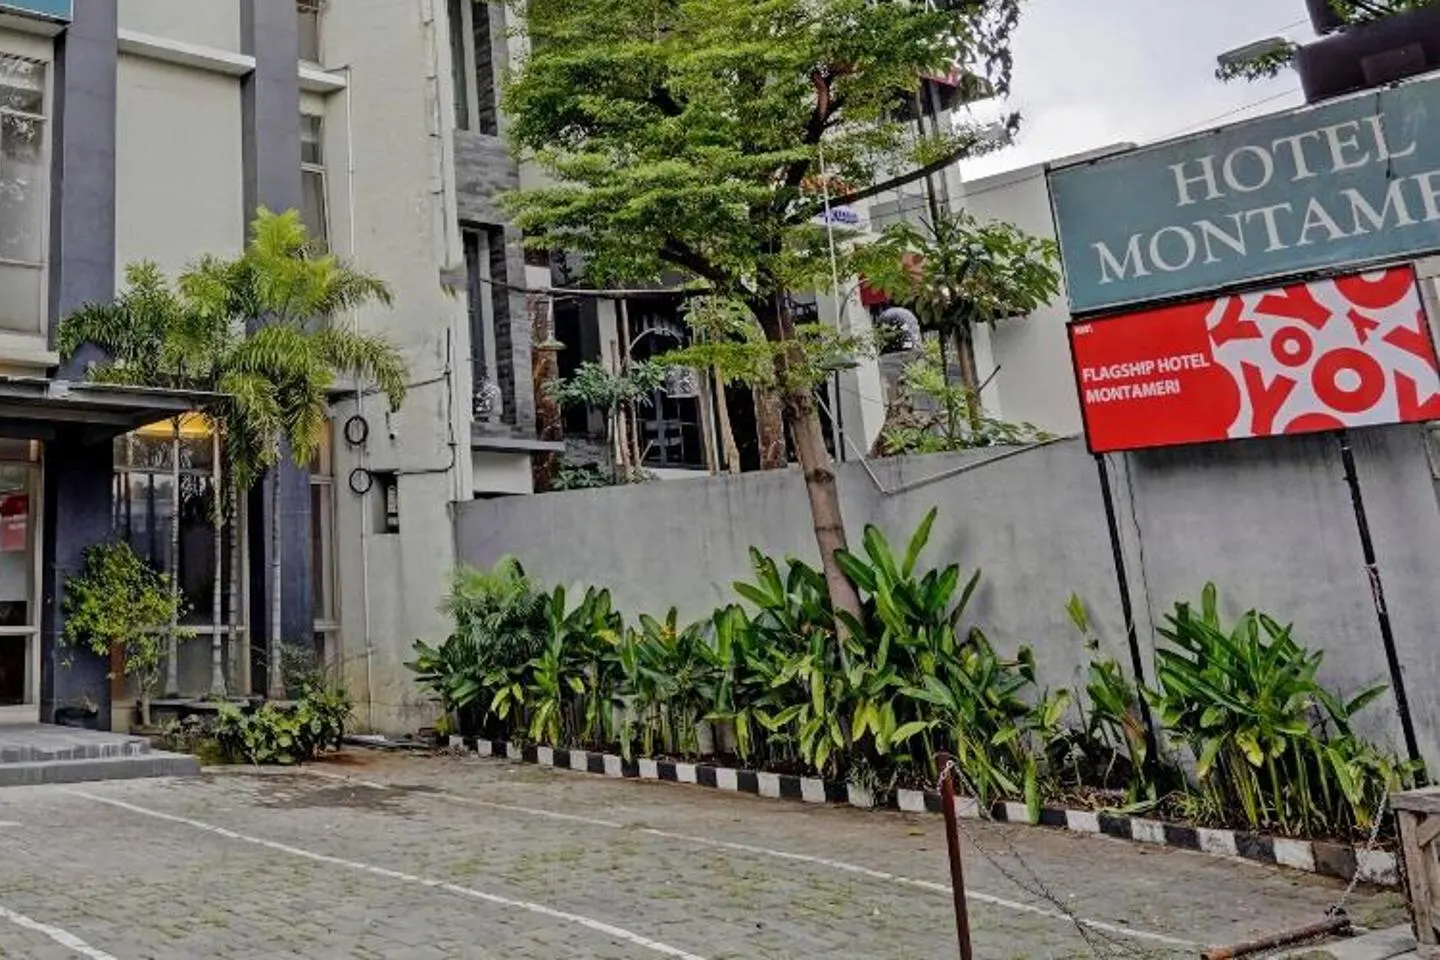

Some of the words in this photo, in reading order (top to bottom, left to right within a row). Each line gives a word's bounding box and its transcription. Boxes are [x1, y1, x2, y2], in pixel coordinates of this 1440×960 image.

[1170, 113, 1416, 206] HOTEL
[1092, 170, 1440, 284] MONTAME
[1082, 360, 1155, 383] FLAGSHIP
[1157, 353, 1210, 374] HOTEL
[1085, 378, 1181, 404] MONTAMERI
